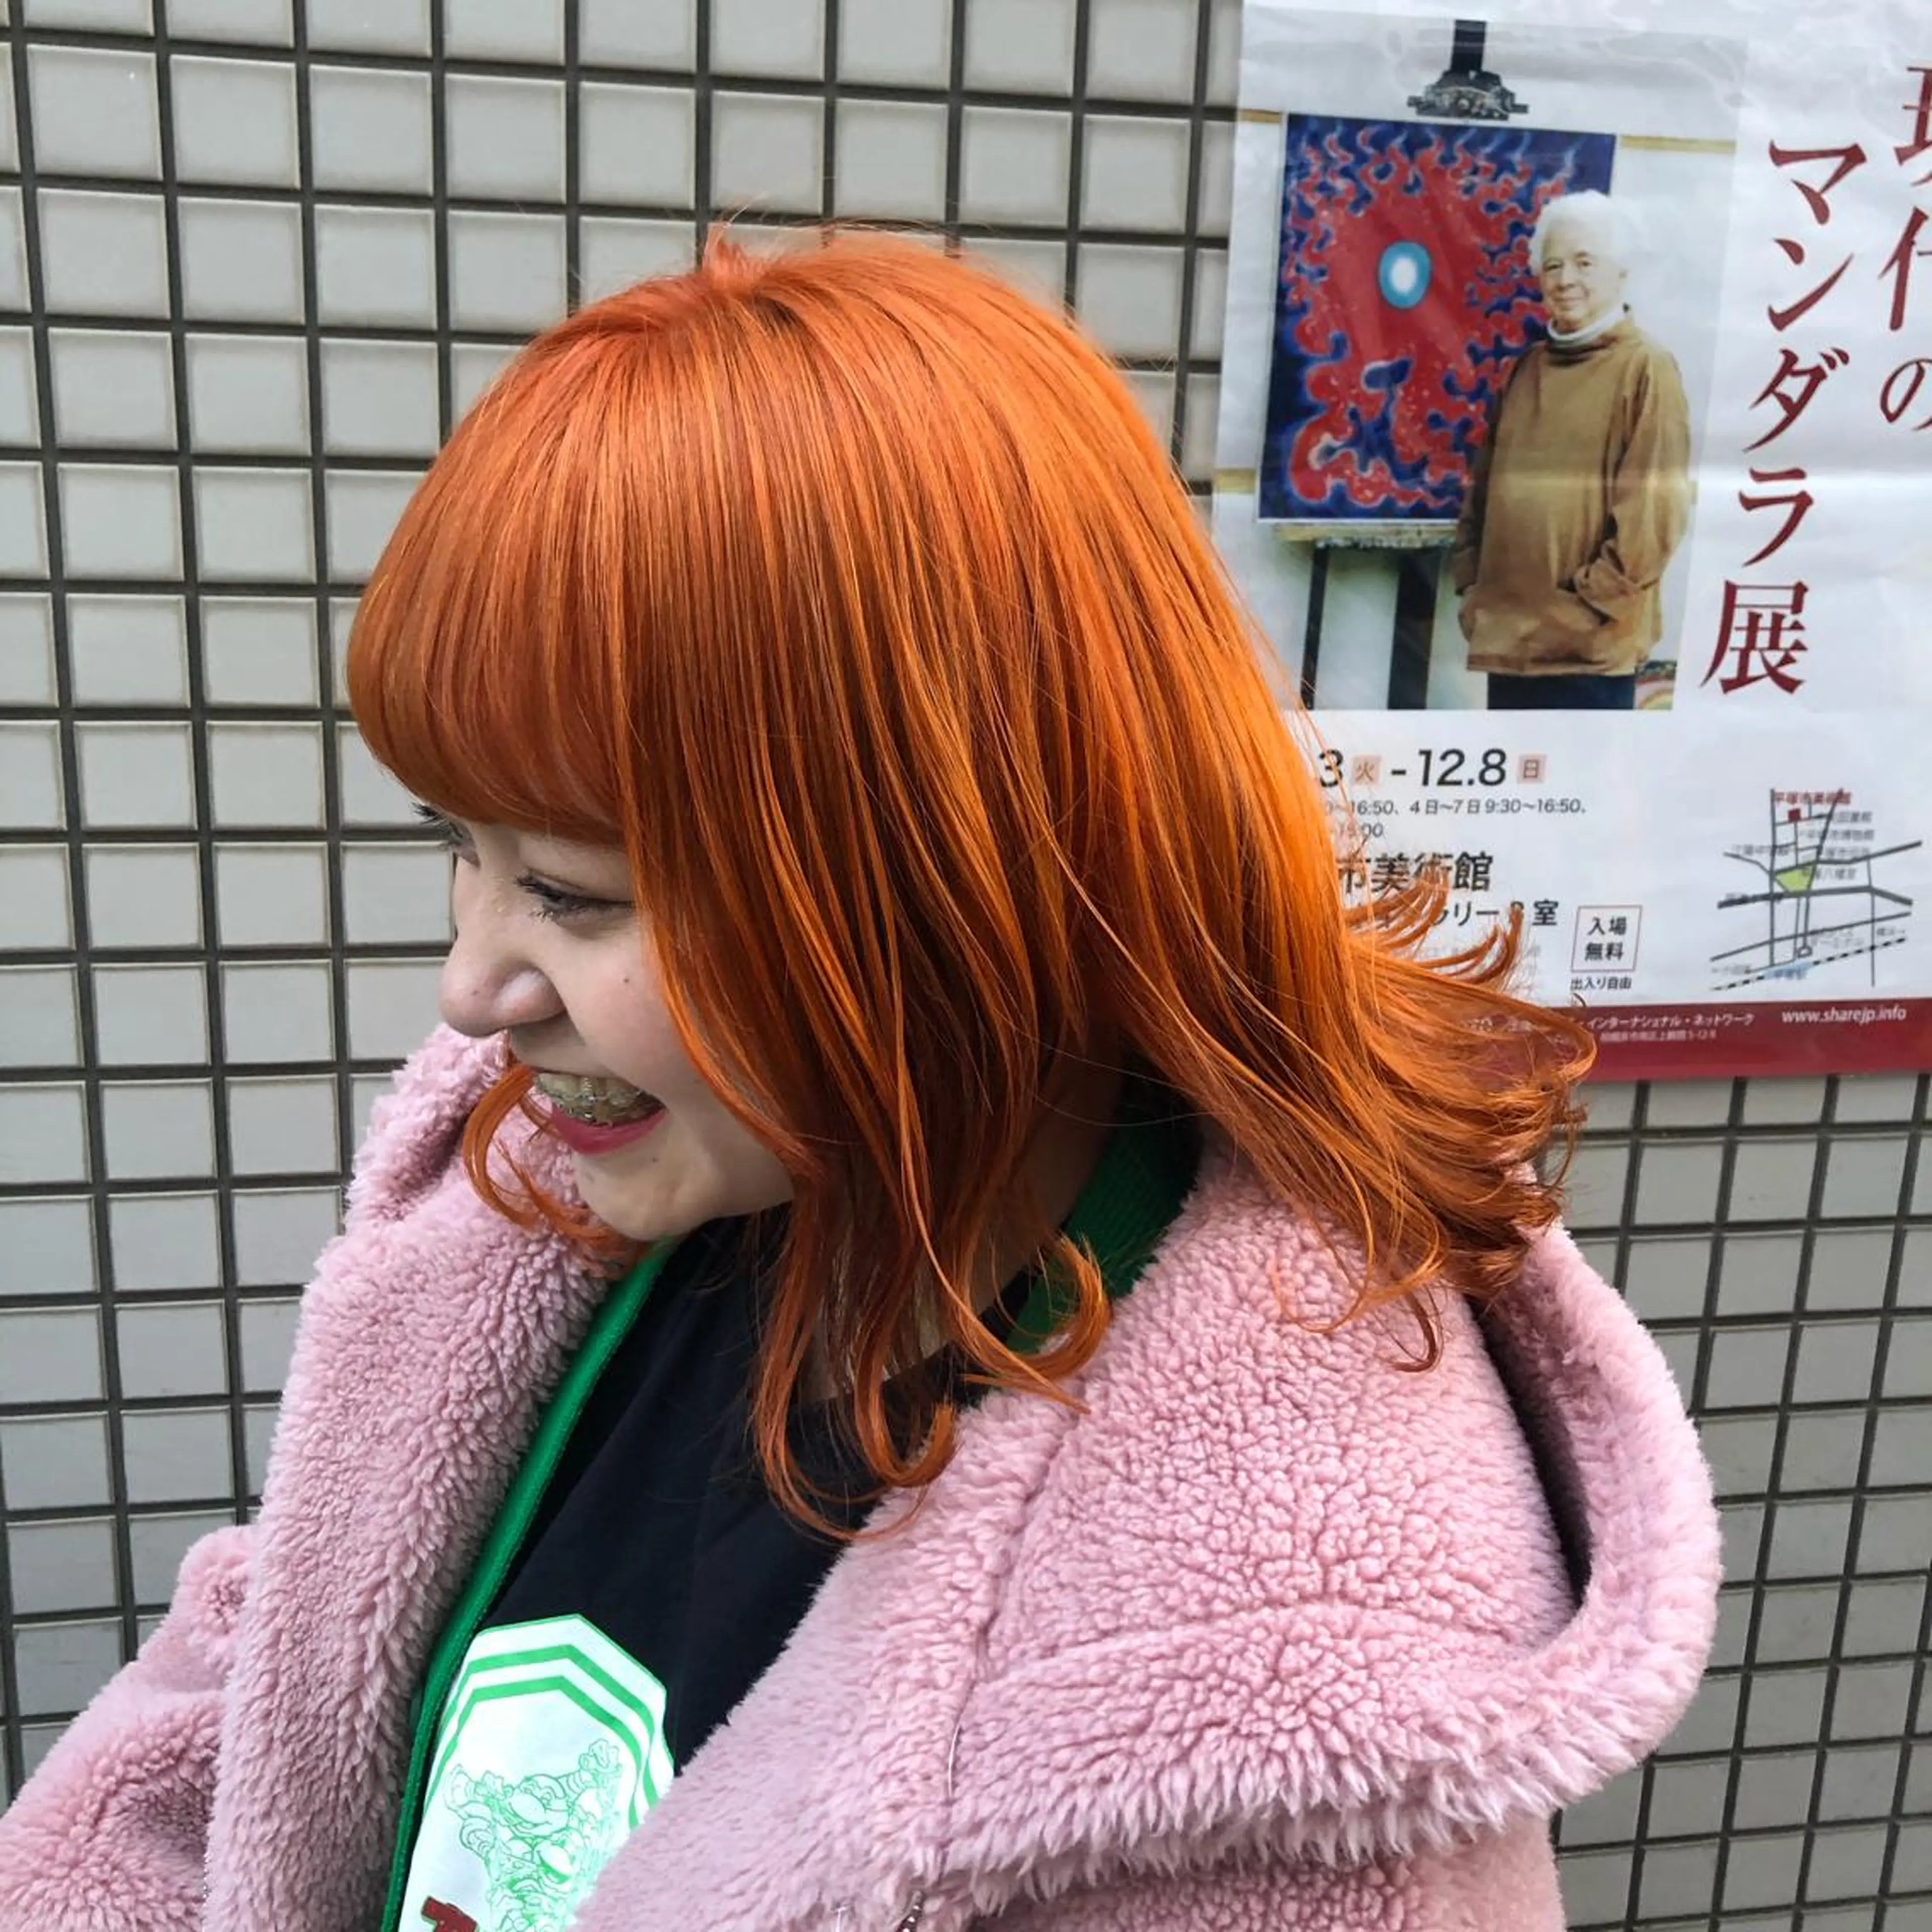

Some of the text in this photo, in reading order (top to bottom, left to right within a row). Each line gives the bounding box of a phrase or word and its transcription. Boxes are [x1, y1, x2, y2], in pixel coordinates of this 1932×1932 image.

[1699, 139, 1867, 695] マンダラ展
[1570, 976, 1632, 991] 出入り自由
[1782, 1004, 1907, 1025] www.sharejp.info
